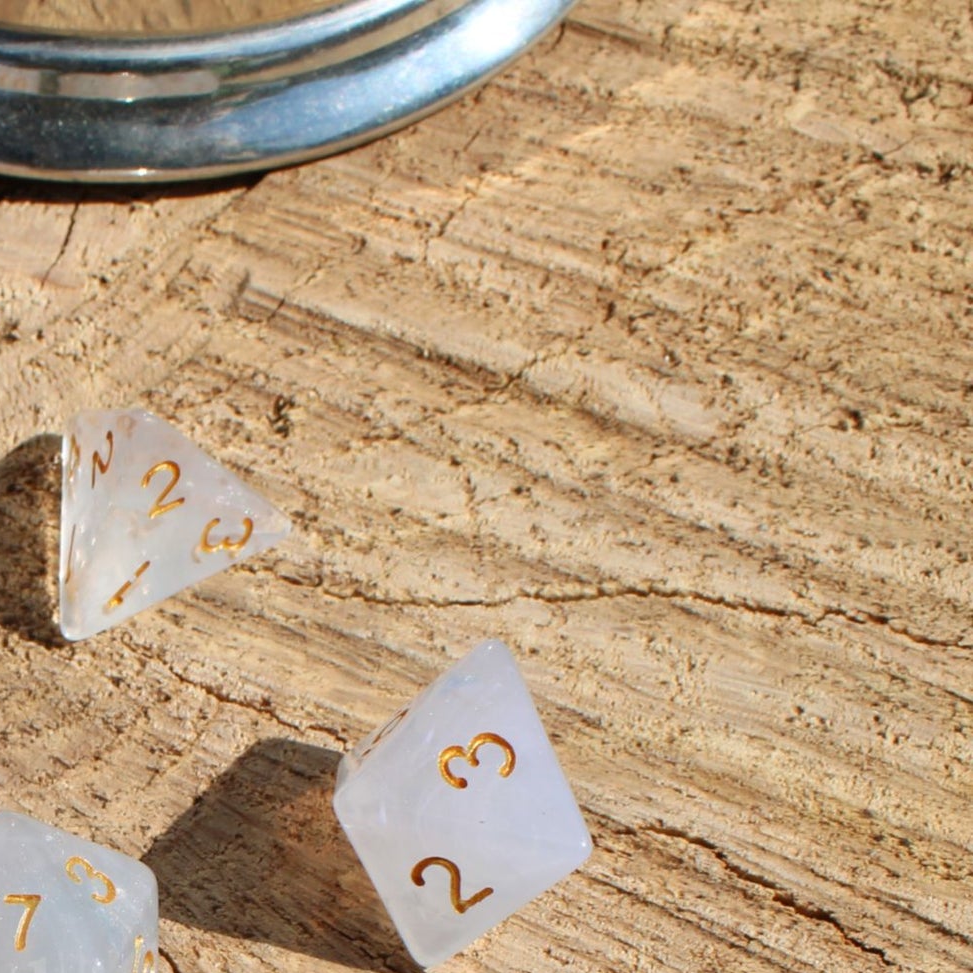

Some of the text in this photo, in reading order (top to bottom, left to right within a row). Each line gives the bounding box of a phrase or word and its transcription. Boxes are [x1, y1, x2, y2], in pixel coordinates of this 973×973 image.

[141, 460, 185, 519] 2
[437, 732, 516, 789] 3
[65, 856, 117, 904] 3
[411, 856, 494, 914] 2
